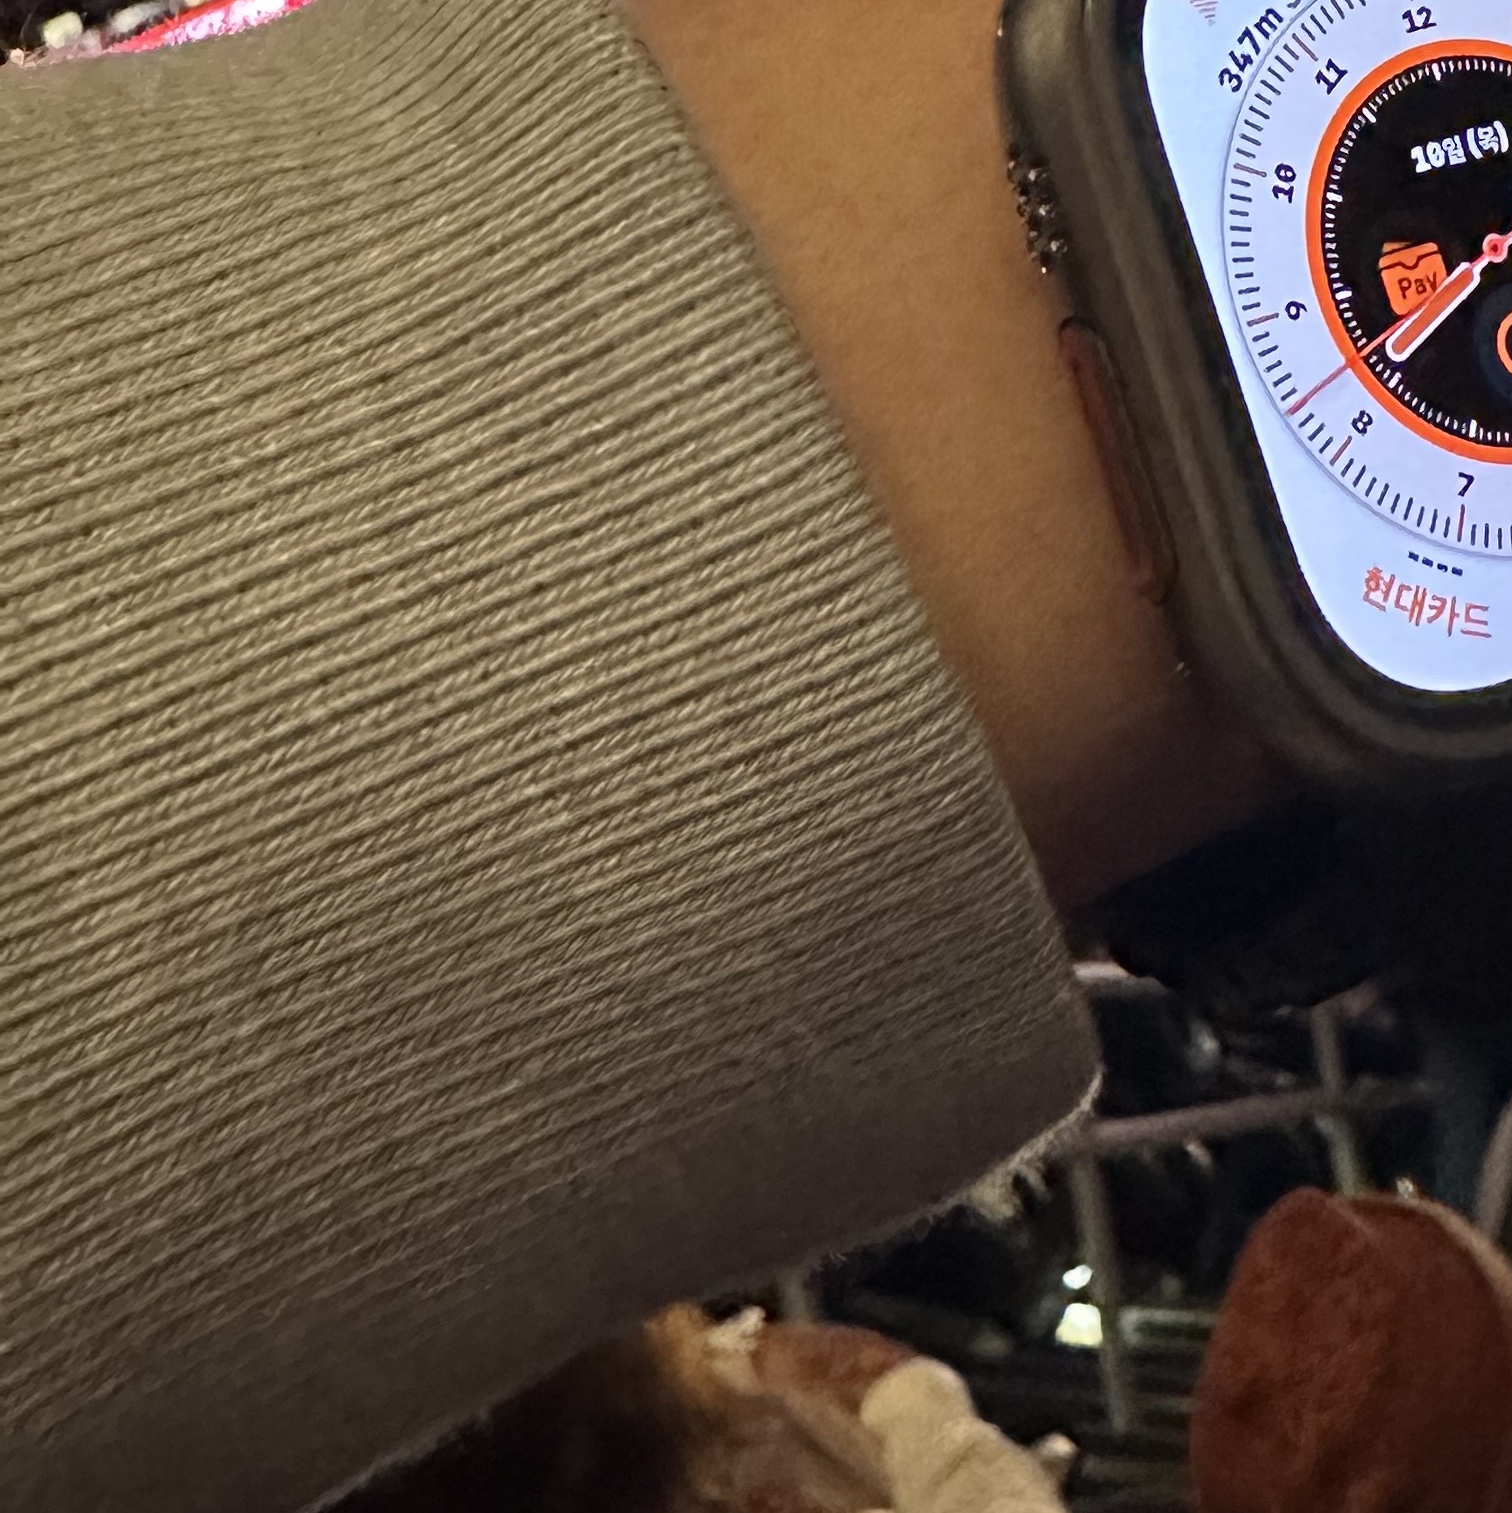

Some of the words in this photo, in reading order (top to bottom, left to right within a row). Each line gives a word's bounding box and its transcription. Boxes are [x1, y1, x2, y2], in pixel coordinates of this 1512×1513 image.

[1402, 6, 1437, 34] 12
[1218, 7, 1284, 93] 347m
[1314, 58, 1348, 95] 11
[1272, 163, 1297, 204] 10
[1284, 300, 1307, 321] 9
[1351, 409, 1373, 437] 8
[1458, 471, 1475, 497] 7
[1362, 566, 1492, 639] 현대카드
